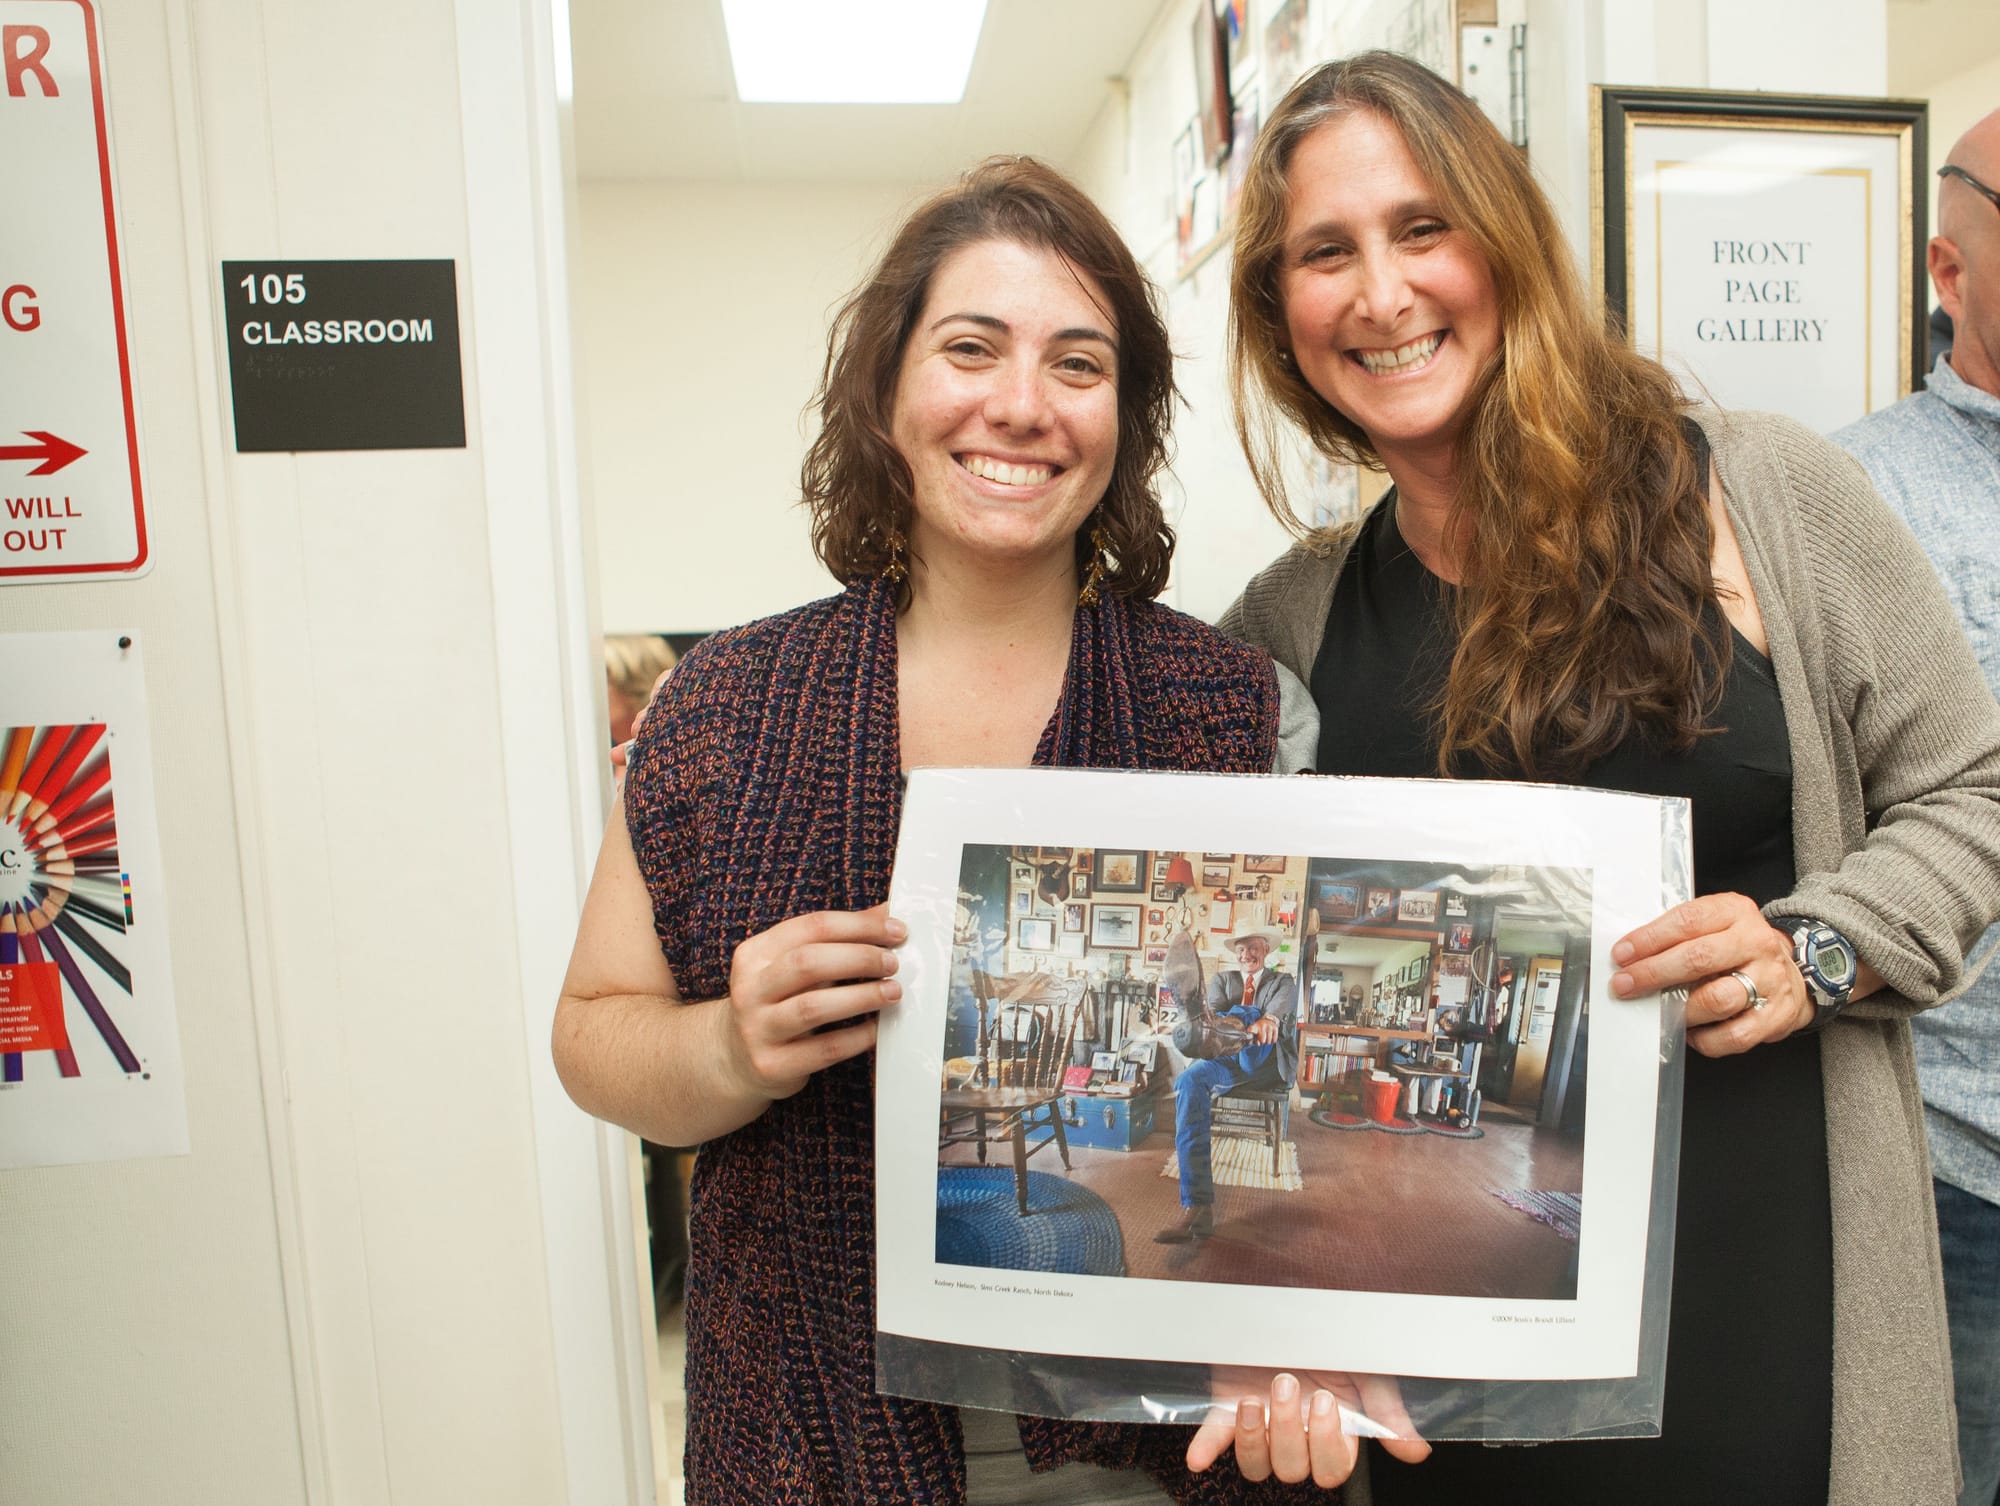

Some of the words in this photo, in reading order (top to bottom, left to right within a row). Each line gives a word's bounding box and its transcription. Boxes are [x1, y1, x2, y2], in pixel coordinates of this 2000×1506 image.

[3, 25, 60, 97] R
[1713, 241, 1812, 264] FRONT
[240, 274, 307, 304] 105
[1726, 280, 1801, 303] PAGE
[2, 285, 41, 332] G
[242, 319, 433, 344] CLASSROOM
[1697, 318, 1828, 342] GALLERY
[5, 497, 82, 519] WILL
[4, 529, 67, 552] OUT
[934, 1279, 955, 1289] Rodney
[994, 1285, 1011, 1293] Creek
[1034, 1288, 1052, 1296] North
[1053, 1289, 1074, 1297] Dakota
